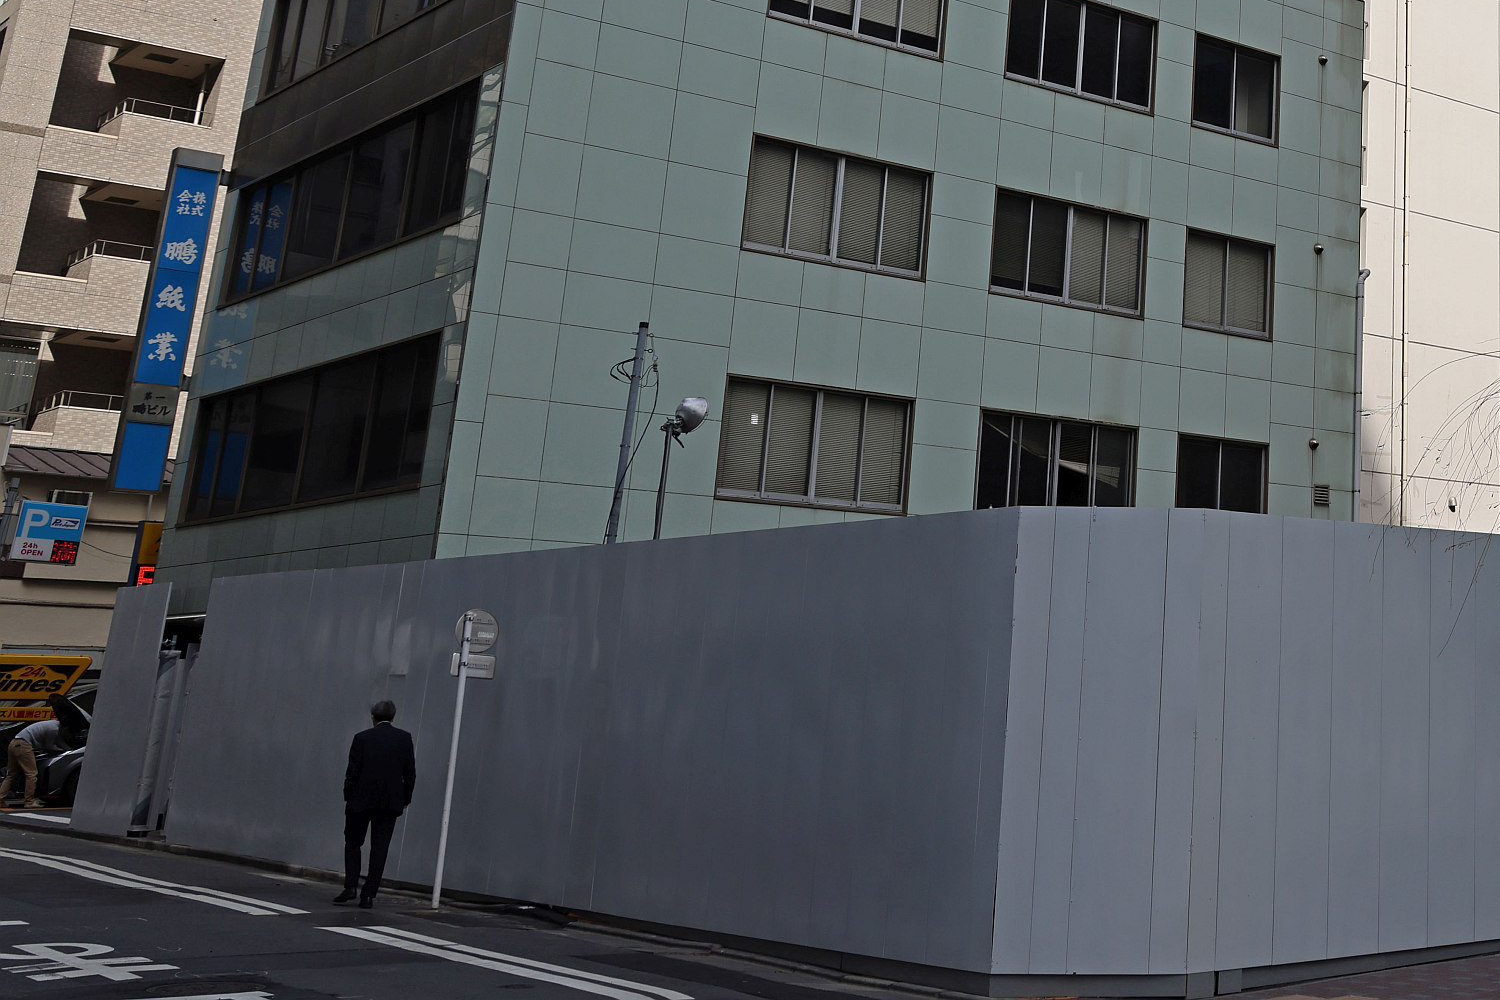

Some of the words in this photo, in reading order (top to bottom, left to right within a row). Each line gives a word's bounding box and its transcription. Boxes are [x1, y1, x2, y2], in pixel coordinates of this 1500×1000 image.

[21, 508, 50, 539] P
[20, 548, 44, 557] OPEN
[22, 541, 38, 550] 24h
[0, 672, 66, 693] imes
